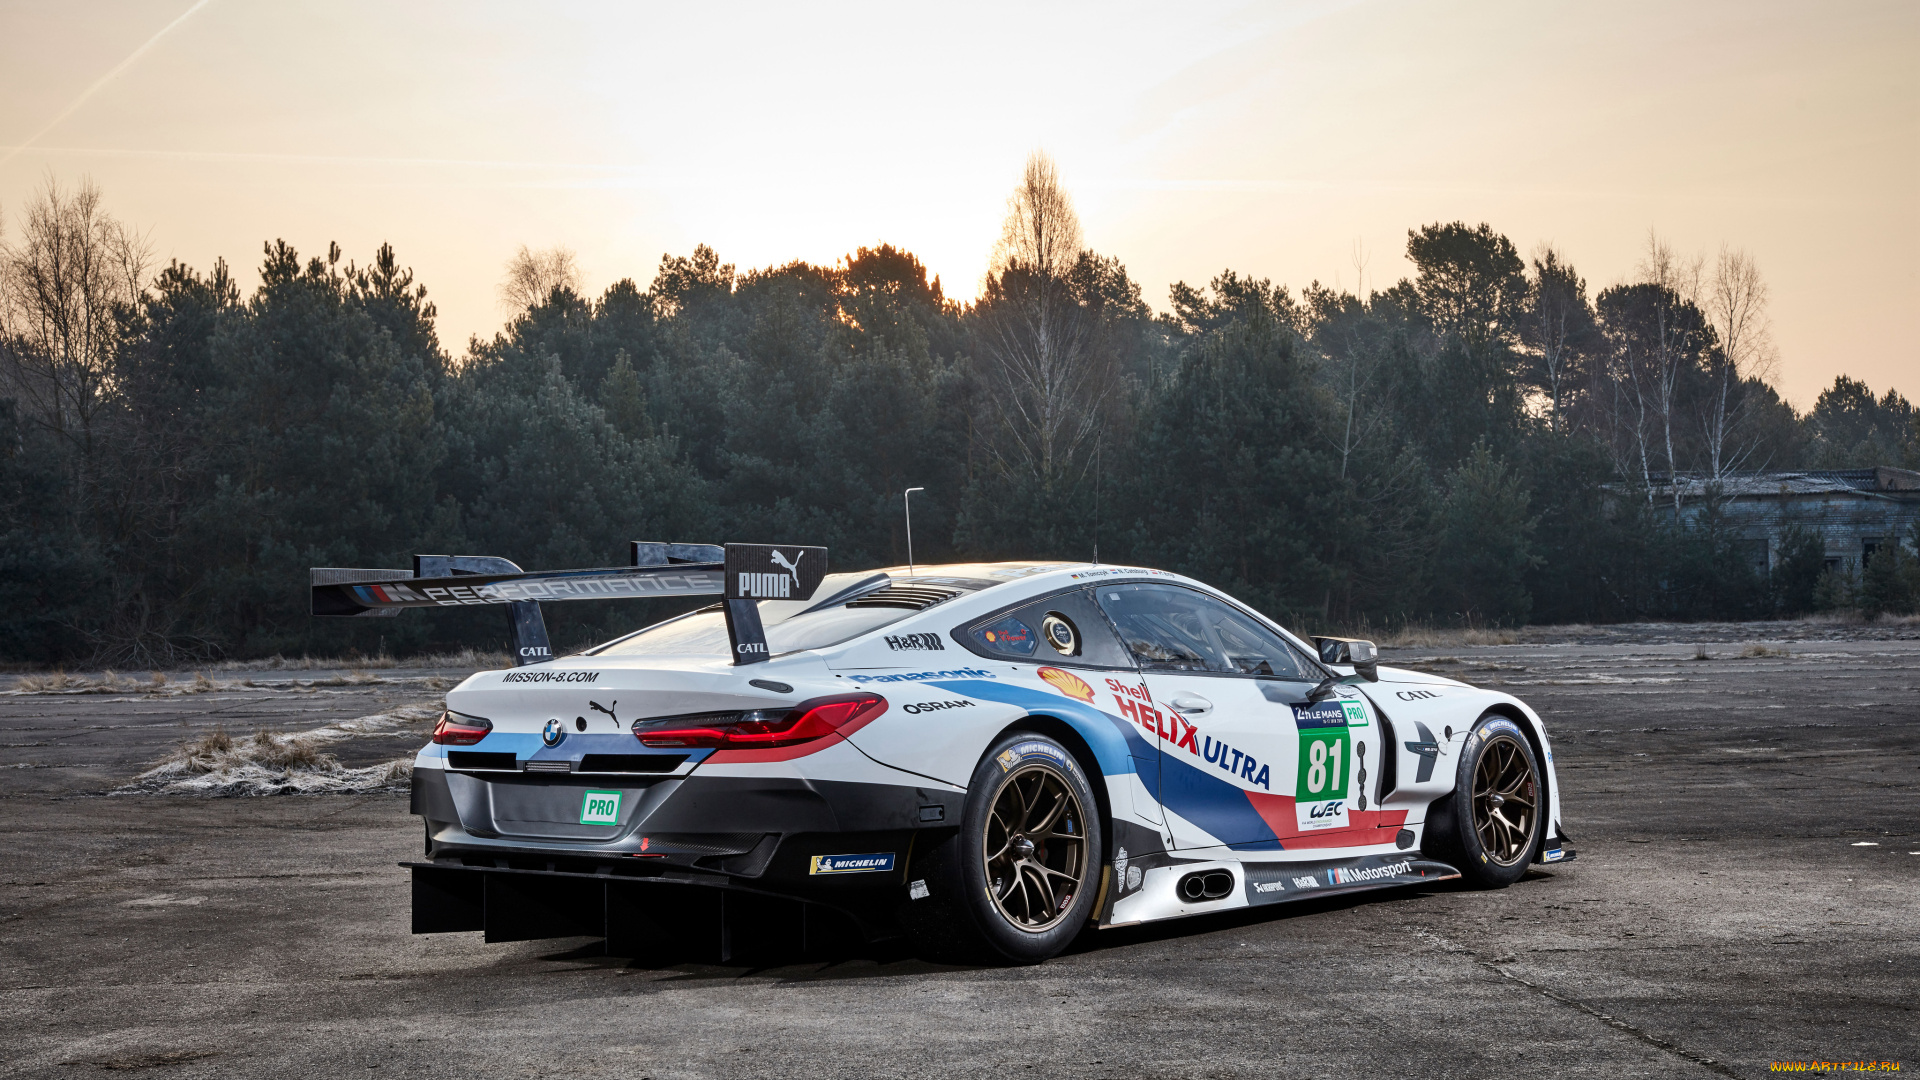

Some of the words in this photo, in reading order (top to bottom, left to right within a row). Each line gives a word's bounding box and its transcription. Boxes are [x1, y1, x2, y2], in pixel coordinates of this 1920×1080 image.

[422, 574, 717, 600] PERFORMANCE
[738, 572, 790, 598] PUMA
[519, 646, 552, 657] CATL
[737, 642, 768, 654] CATL
[883, 633, 926, 652] H&R
[502, 671, 600, 683] MISSION-8.COM
[847, 666, 997, 684] Panasonic
[1104, 678, 1150, 702] Shell
[1395, 690, 1444, 702] CATL
[902, 699, 976, 714] OSRAM
[1311, 710, 1321, 719] LE
[1321, 709, 1343, 719] MANS
[1346, 706, 1364, 720] PRO
[1111, 694, 1199, 756] HELIX
[1203, 735, 1270, 791] ULTRA
[1020, 743, 1065, 761] MICHELIN
[1307, 739, 1342, 793] 81
[587, 798, 615, 817] PRO
[1310, 801, 1343, 818] WEC
[834, 858, 887, 868] MICHELIN
[1350, 860, 1412, 882] Motorsport
